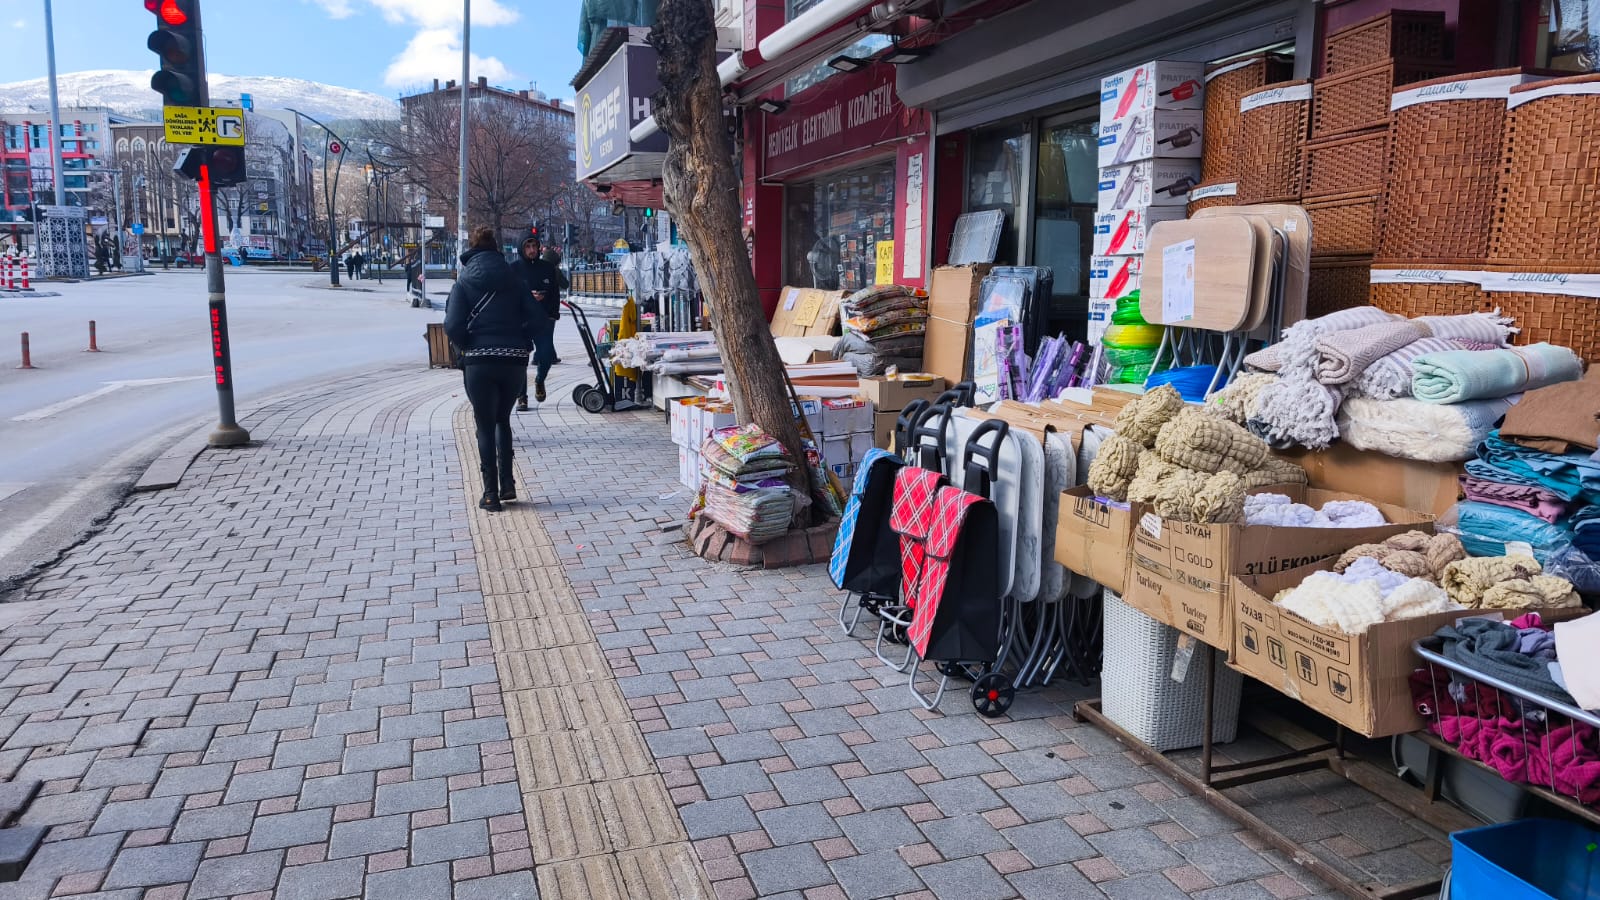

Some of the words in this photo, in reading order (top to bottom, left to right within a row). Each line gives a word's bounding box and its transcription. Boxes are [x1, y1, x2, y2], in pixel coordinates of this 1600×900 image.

[1249, 89, 1284, 102] Laundry
[1416, 82, 1469, 97] Laundry
[590, 86, 620, 147] HEDEF
[768, 120, 798, 158] HEDİYELİK
[803, 100, 842, 145] ELEKTRONİK
[848, 78, 893, 128] KOZMETİK
[1395, 269, 1447, 280] Laundry
[1508, 272, 1570, 286] Laundry
[1185, 524, 1211, 539] SİYAH
[1187, 552, 1213, 569] GOLD
[1136, 571, 1163, 595] Turkey
[1188, 575, 1211, 591] KROM
[1182, 601, 1207, 624] Turkey
[1240, 602, 1263, 623] BEYAZ
